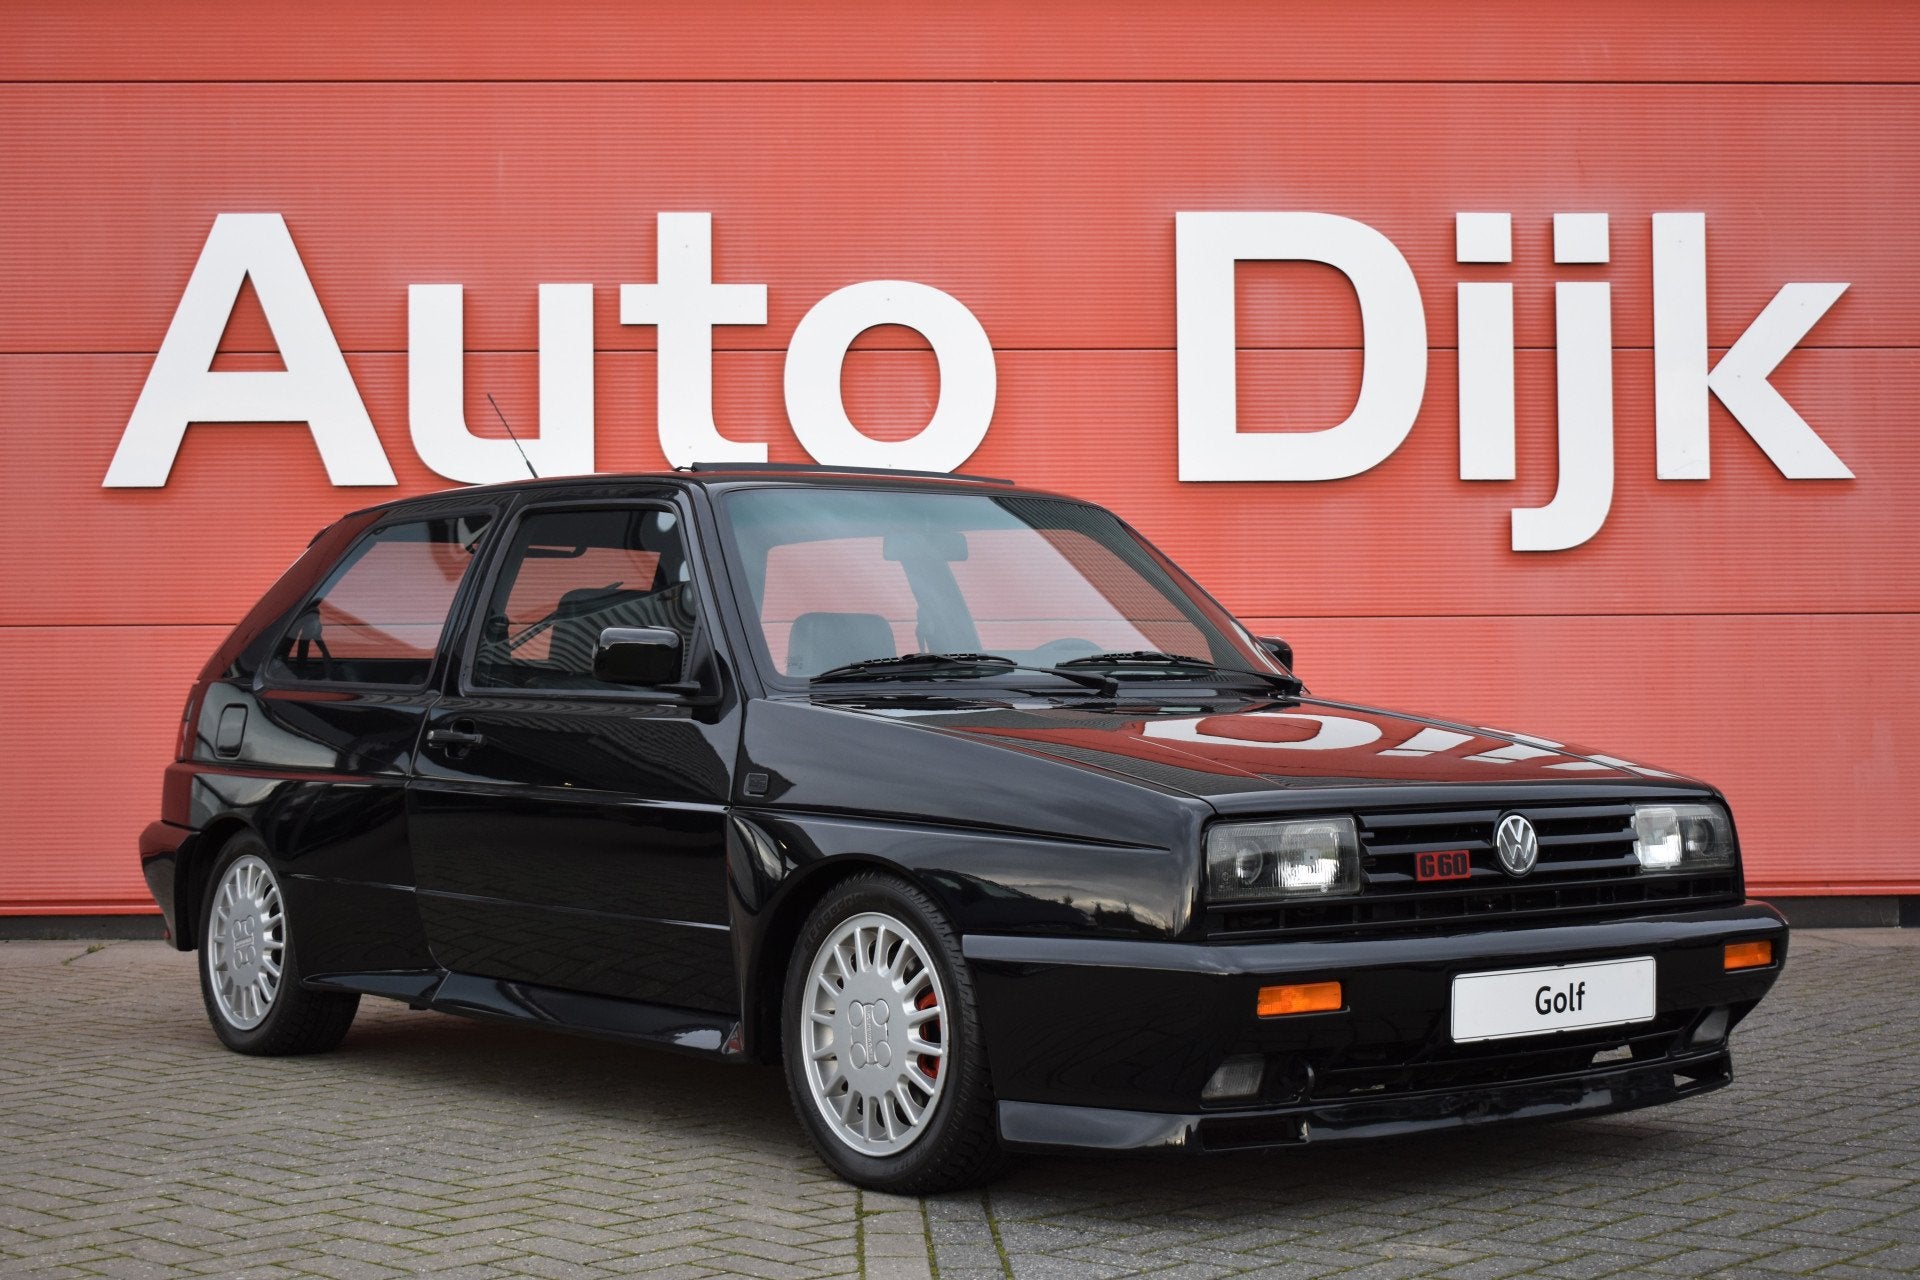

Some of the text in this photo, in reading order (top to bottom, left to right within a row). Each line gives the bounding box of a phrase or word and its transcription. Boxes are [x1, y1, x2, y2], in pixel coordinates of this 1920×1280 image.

[102, 211, 1856, 551] Auto Dijk
[1535, 981, 1585, 1015] Golf
